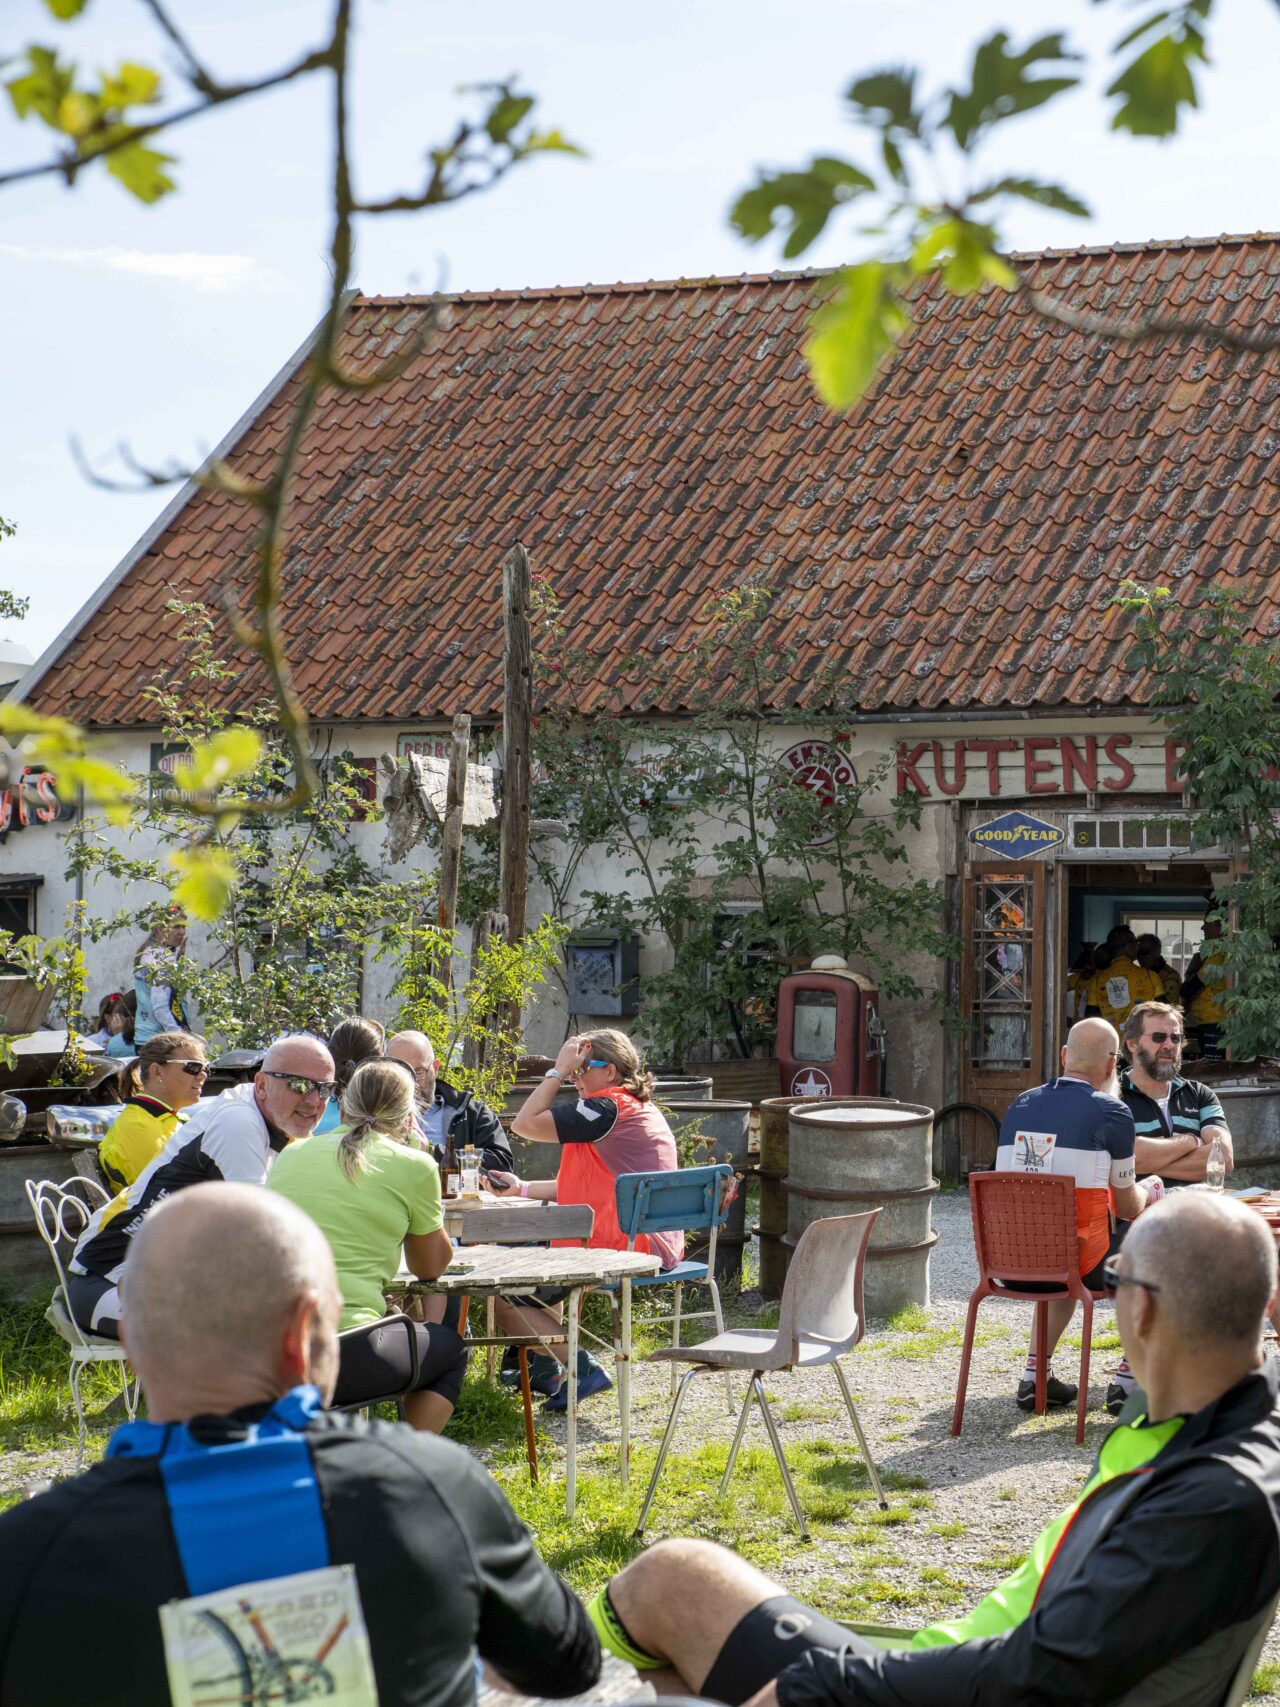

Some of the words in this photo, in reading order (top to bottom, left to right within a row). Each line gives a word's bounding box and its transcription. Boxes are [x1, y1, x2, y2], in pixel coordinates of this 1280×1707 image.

[897, 733, 1134, 797] KUTENS
[975, 830, 1012, 841] GOOD
[1023, 830, 1058, 841] YEAR
